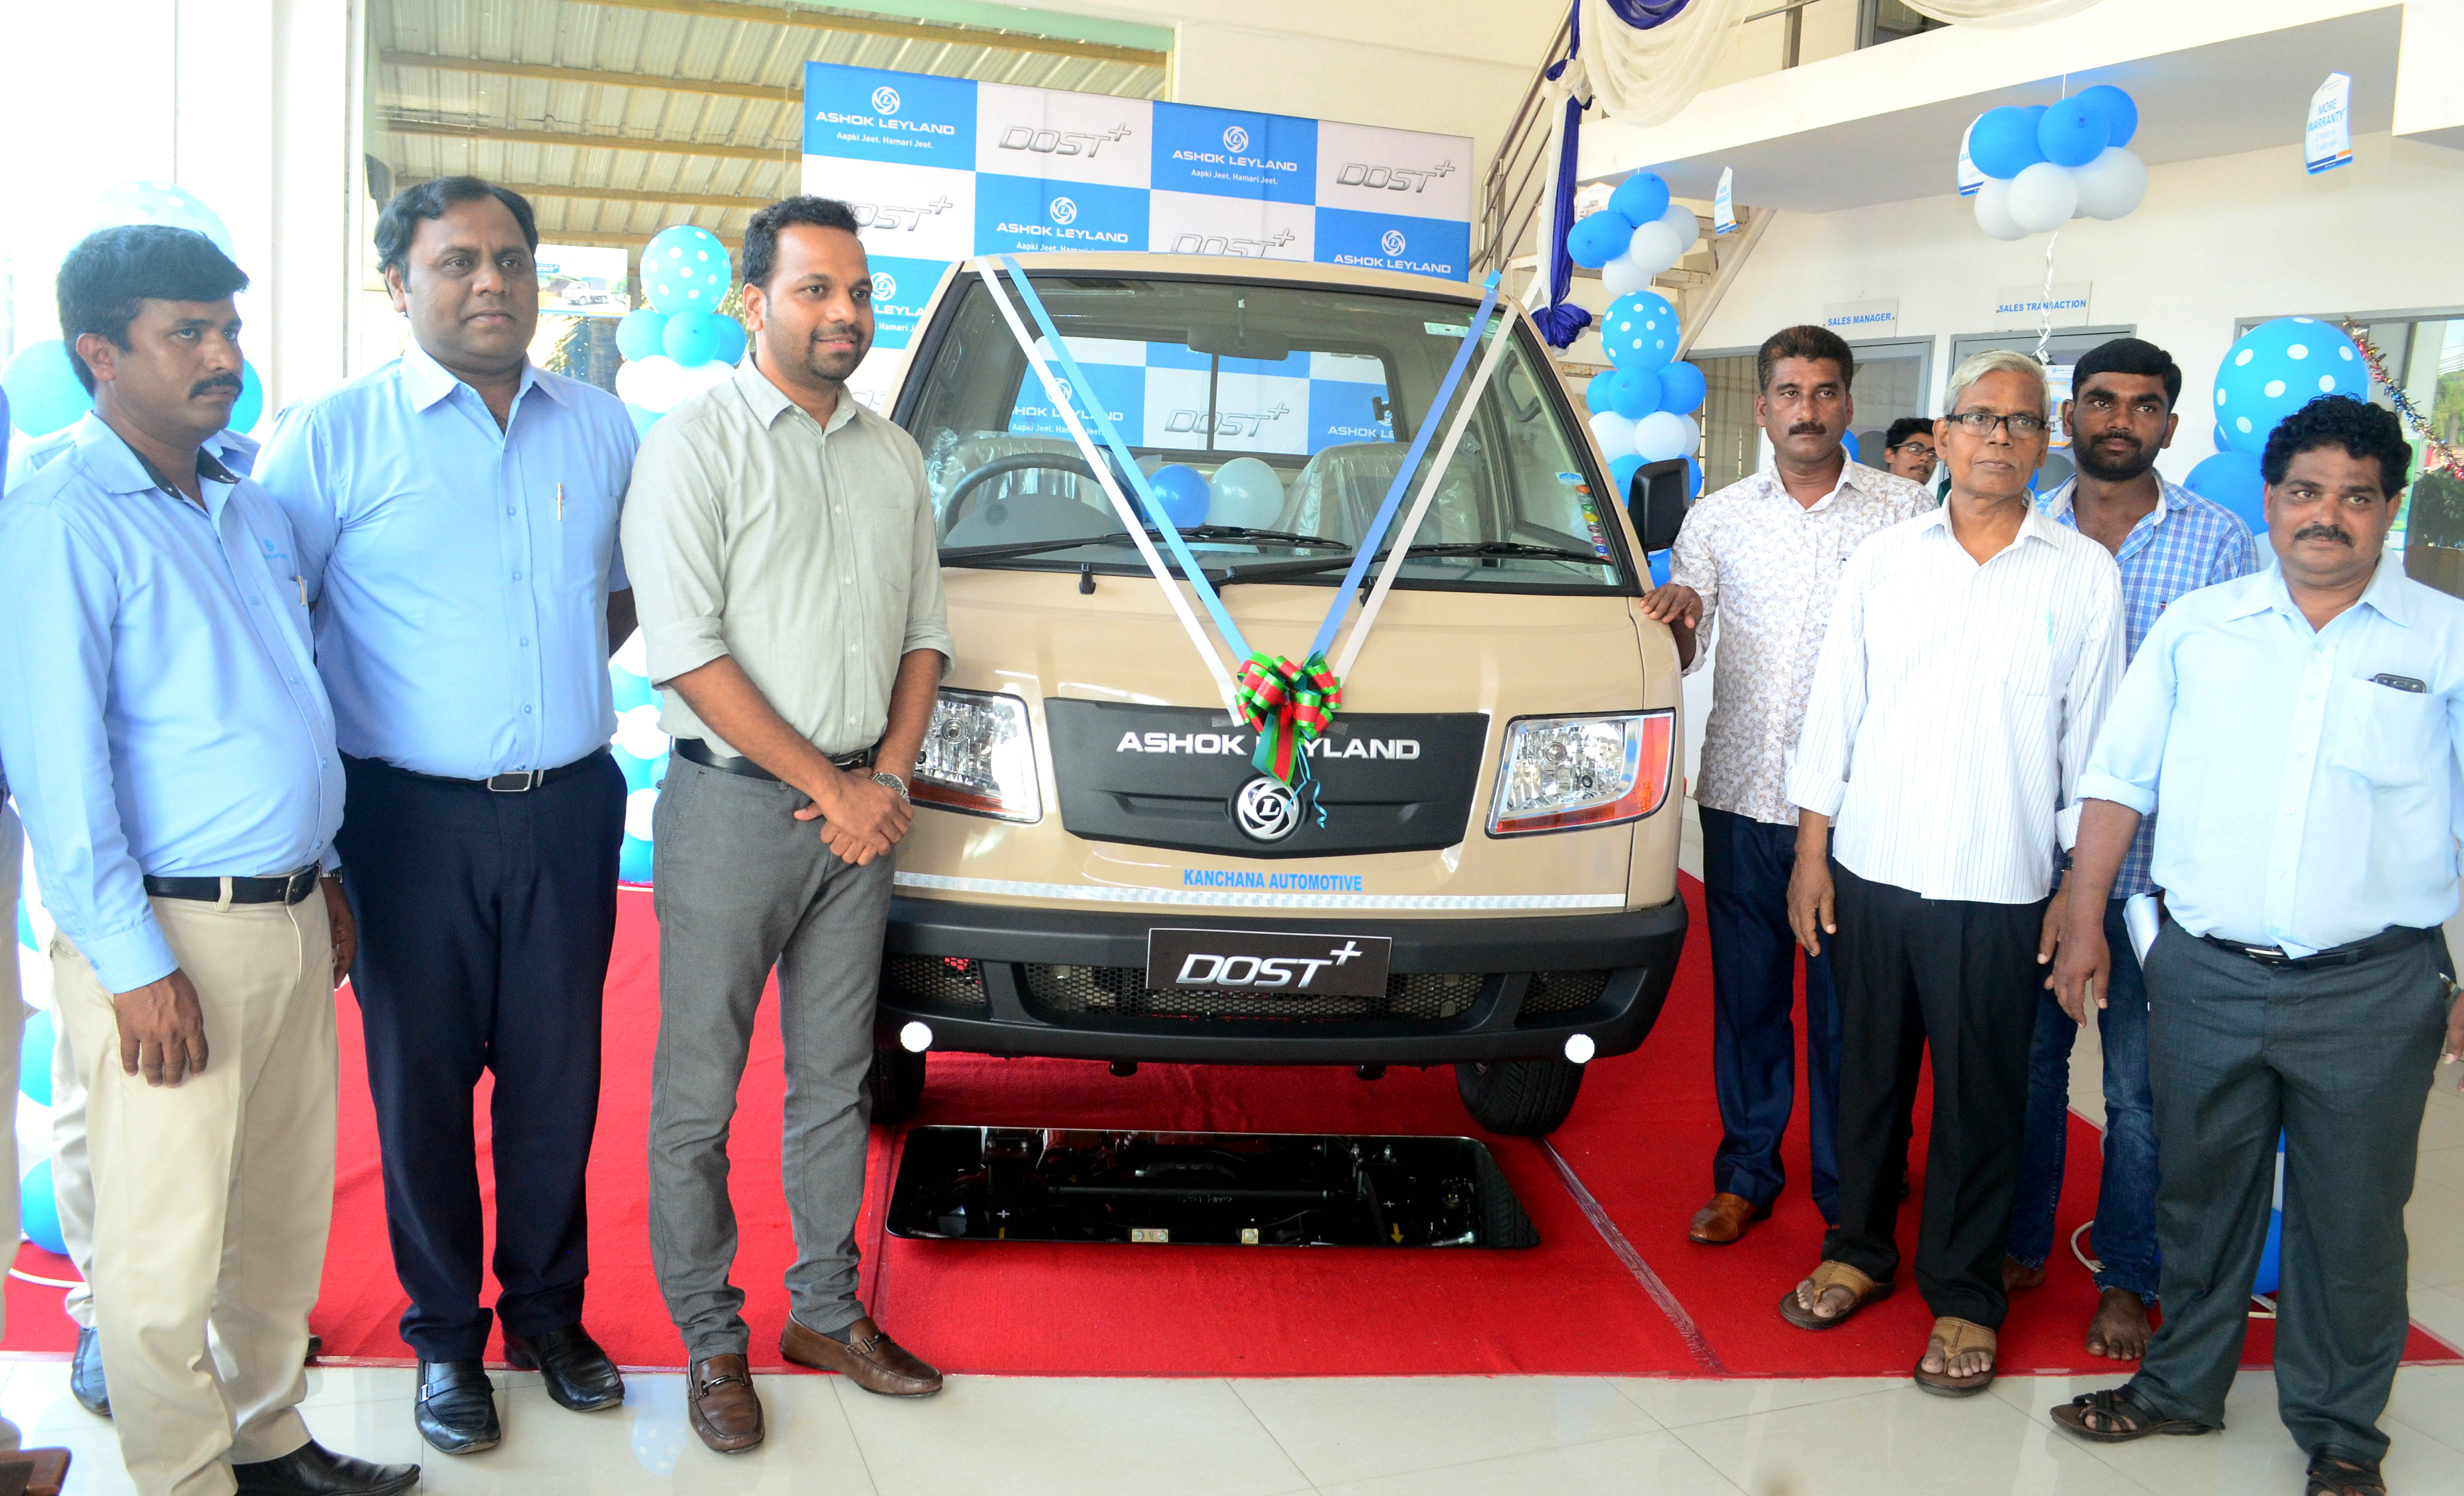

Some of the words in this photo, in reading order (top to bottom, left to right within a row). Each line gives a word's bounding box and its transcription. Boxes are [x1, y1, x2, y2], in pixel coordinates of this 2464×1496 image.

[2318, 98, 2336, 114] MORE
[816, 112, 874, 126] ASHOK
[879, 118, 954, 135] LEYLAND
[836, 132, 859, 141] Aapki
[862, 134, 880, 144] Jeet.
[883, 137, 912, 146] Hamari
[914, 140, 933, 148] Jeet.
[1172, 150, 1225, 164] ASHOK
[1229, 156, 1297, 172] LEYLAND
[1191, 169, 1212, 178] Aapki
[1214, 172, 1230, 180] Jeet.
[1232, 174, 1259, 182] Hamari
[1260, 176, 1278, 184] Jeet.
[852, 195, 952, 232] OST+
[996, 222, 1052, 236] ASHOK
[1056, 228, 1128, 243] LEYLAND
[1016, 242, 1038, 251] Aapki
[1334, 254, 1383, 267] ASHOK
[1387, 258, 1451, 274] LEYLAND
[874, 304, 924, 316] LEYLA
[1999, 304, 2024, 312] SALES
[2026, 300, 2086, 310] TRANSACTION
[1828, 316, 1850, 326] SALES
[1853, 312, 1891, 324] MANAGER
[878, 322, 908, 332] Hamari
[1012, 406, 1048, 416] HOK
[1012, 424, 1033, 432] Aapki
[1036, 424, 1054, 432] Jeet.
[1328, 426, 1377, 438] ASHOK
[1116, 732, 1248, 756] ASHOK
[1256, 736, 1420, 760] YLAND
[1184, 869, 1264, 888] KANCHANA
[1269, 872, 1362, 892] AUTOMOTIVE
